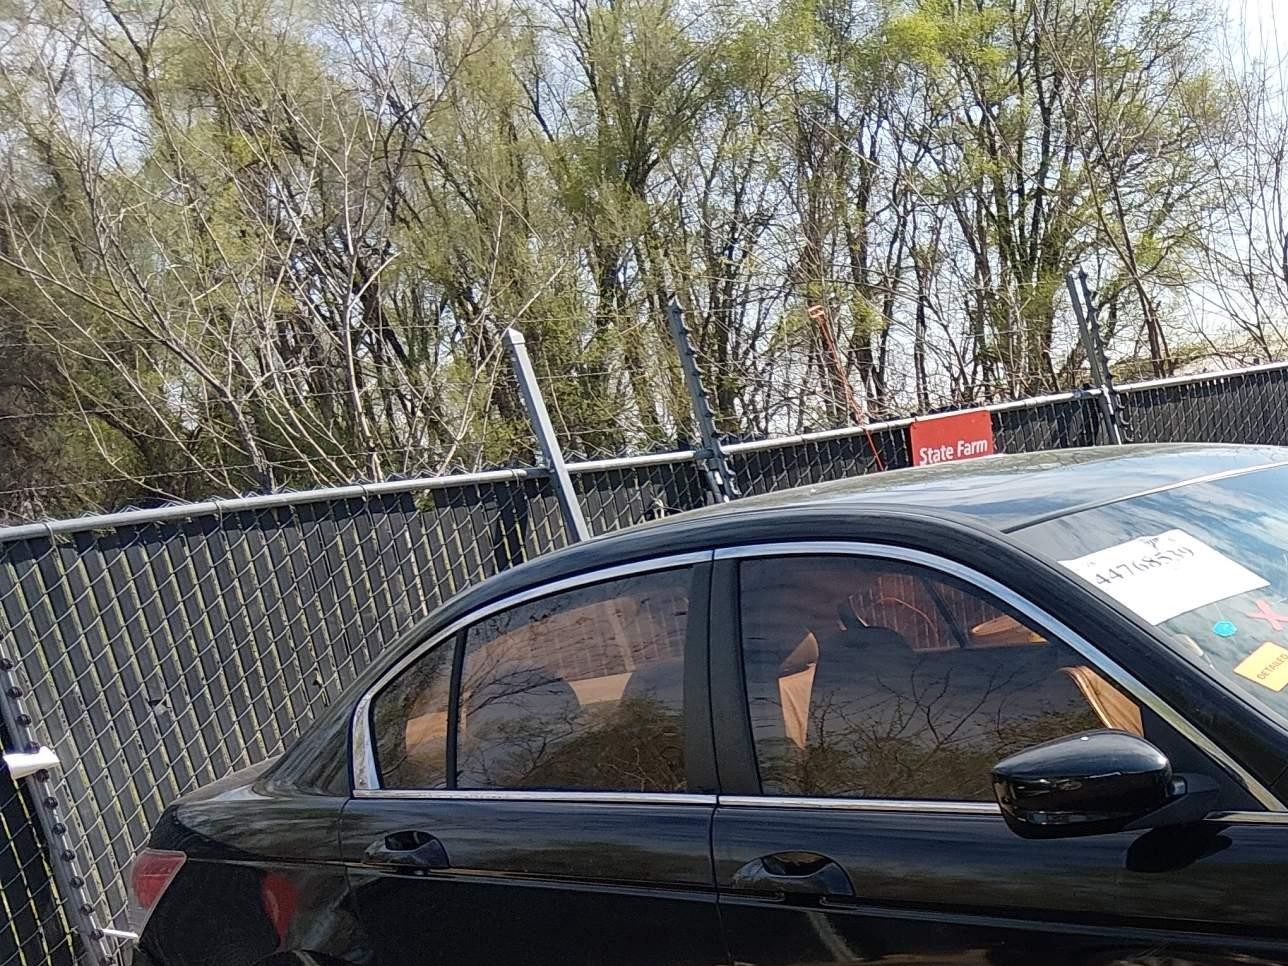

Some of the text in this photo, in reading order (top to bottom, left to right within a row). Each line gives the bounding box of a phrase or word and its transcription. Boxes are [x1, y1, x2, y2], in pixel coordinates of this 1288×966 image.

[919, 439, 988, 465] State Farm
[1095, 546, 1195, 585] 44768539
[1256, 653, 1288, 680] DETAILED
